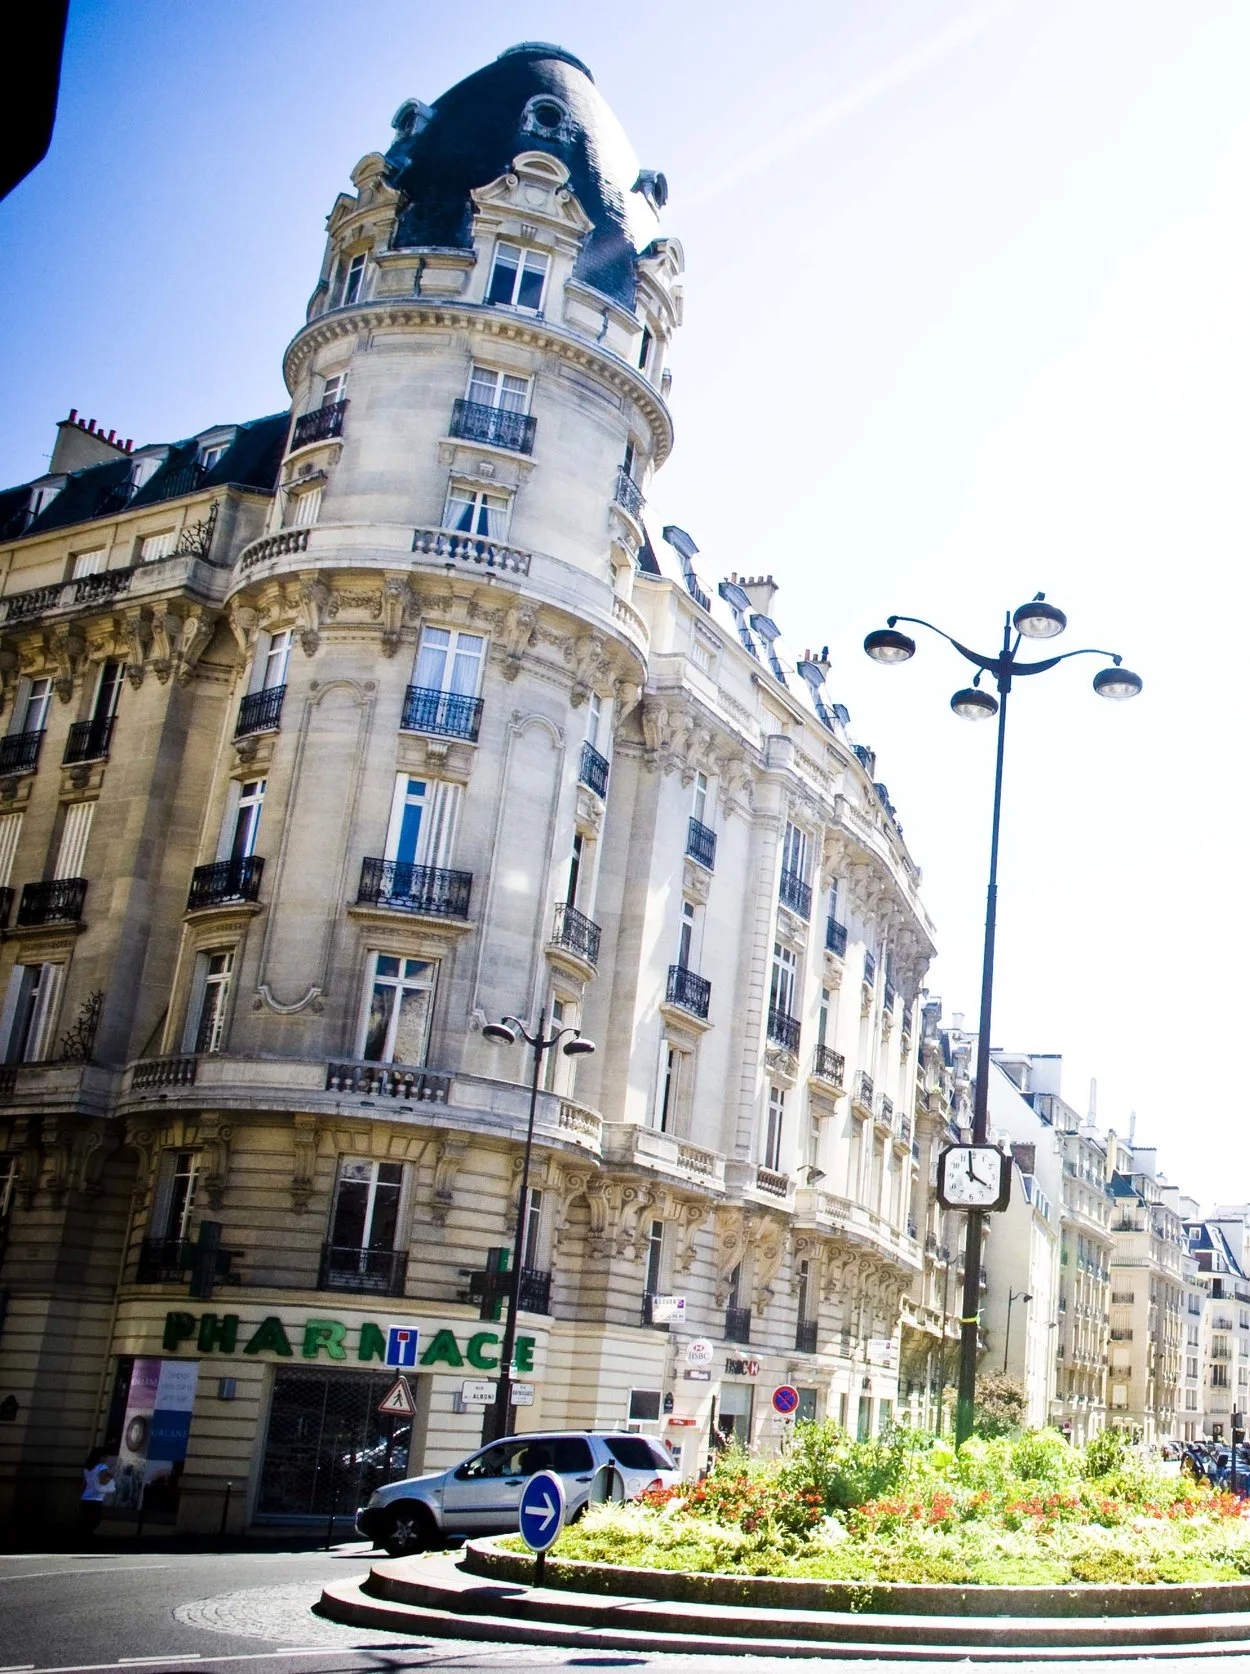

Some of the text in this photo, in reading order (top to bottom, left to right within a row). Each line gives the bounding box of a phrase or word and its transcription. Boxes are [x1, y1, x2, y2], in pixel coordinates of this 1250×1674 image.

[162, 1311, 537, 1372] PHARMACE
[688, 1352, 709, 1360] HSBC
[725, 1357, 748, 1376] HSBC
